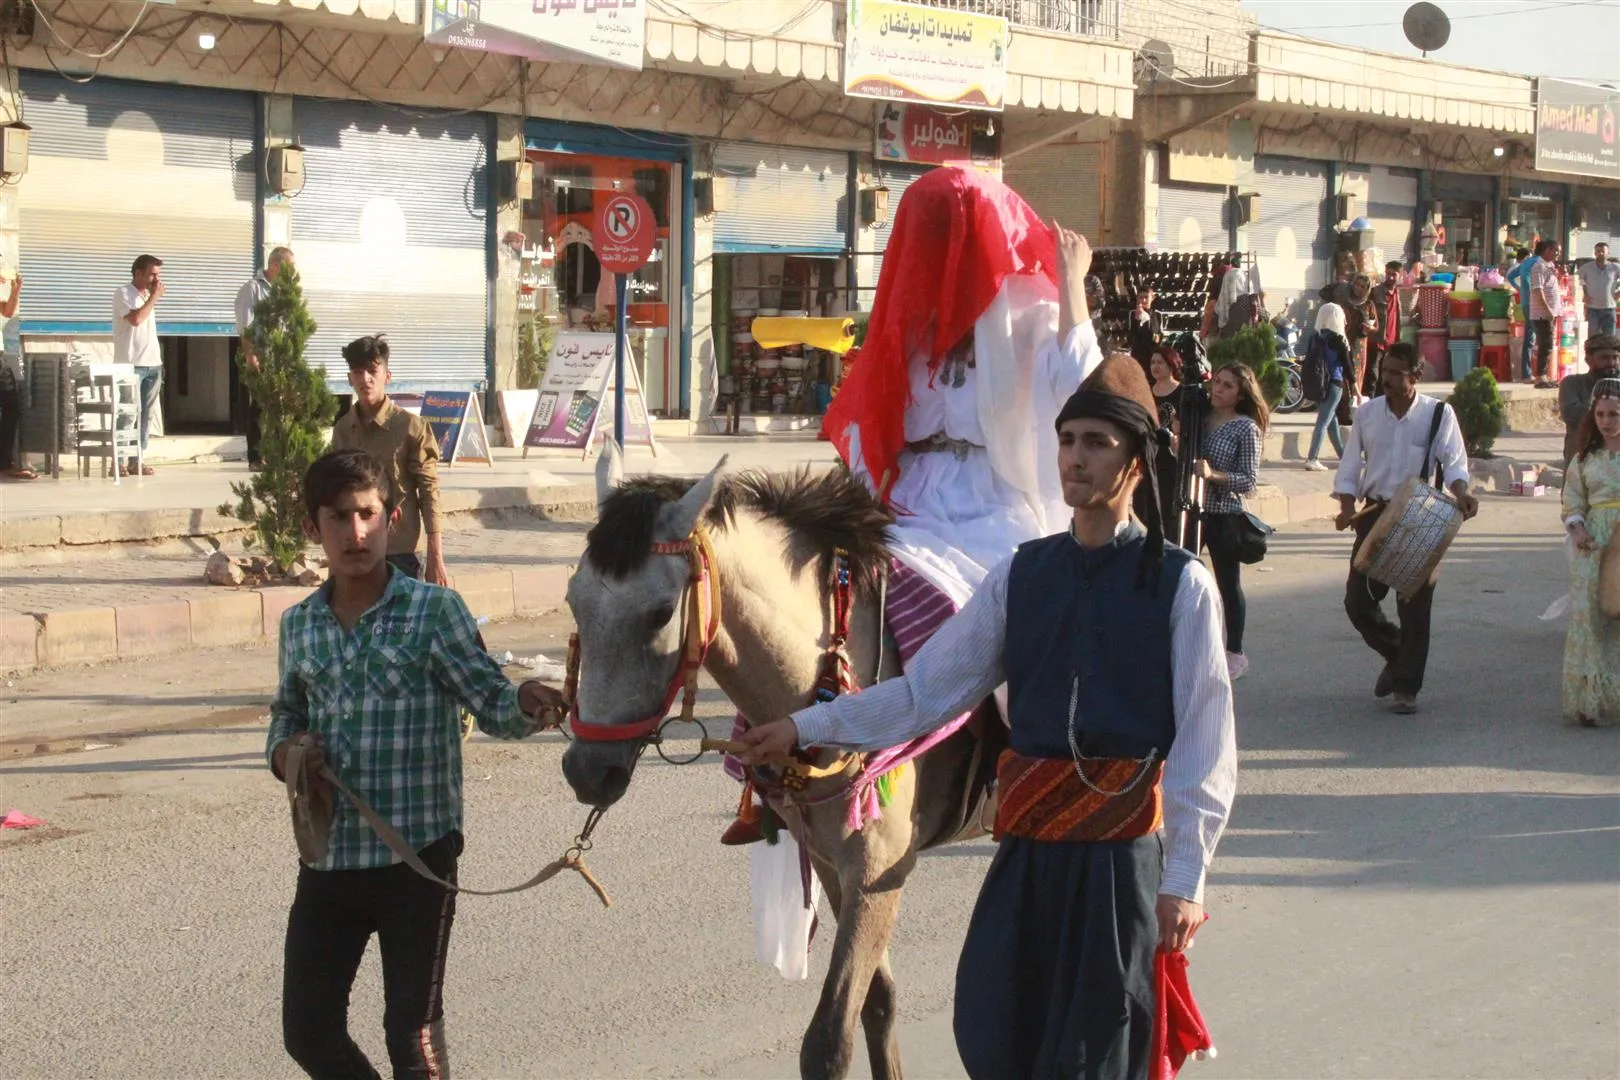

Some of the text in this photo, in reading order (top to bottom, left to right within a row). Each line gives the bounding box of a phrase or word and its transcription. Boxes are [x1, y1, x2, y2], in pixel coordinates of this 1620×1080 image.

[926, 16, 973, 47] تمديدات
[1541, 99, 1598, 135] Amed Mall
[556, 343, 613, 360] نايس فون
